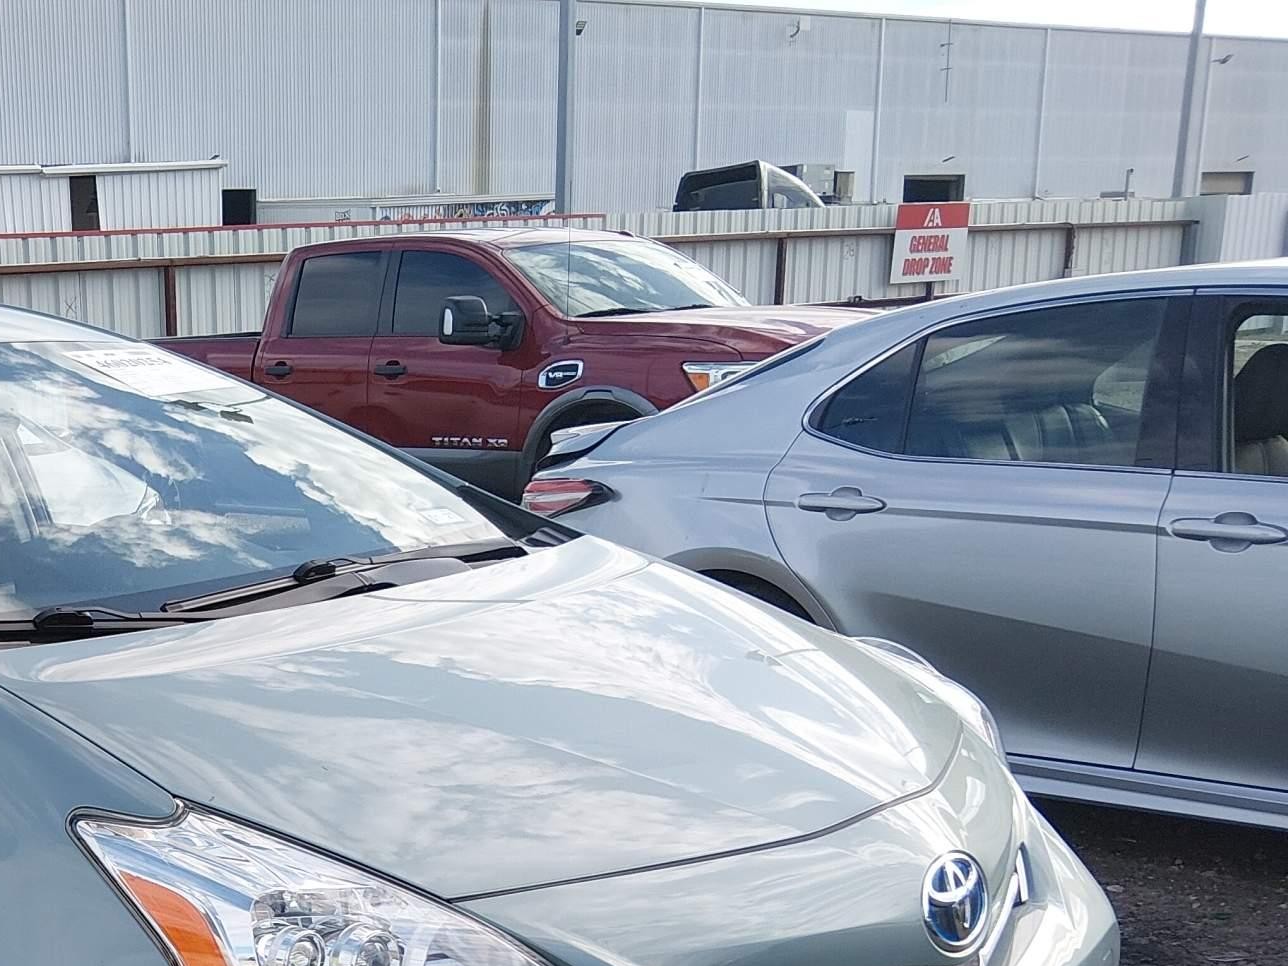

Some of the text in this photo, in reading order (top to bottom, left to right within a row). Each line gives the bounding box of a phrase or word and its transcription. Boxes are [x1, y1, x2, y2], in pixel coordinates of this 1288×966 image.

[909, 234, 950, 254] GENERAL
[902, 256, 954, 276] DROP ZONE
[431, 436, 483, 447] TITAN
